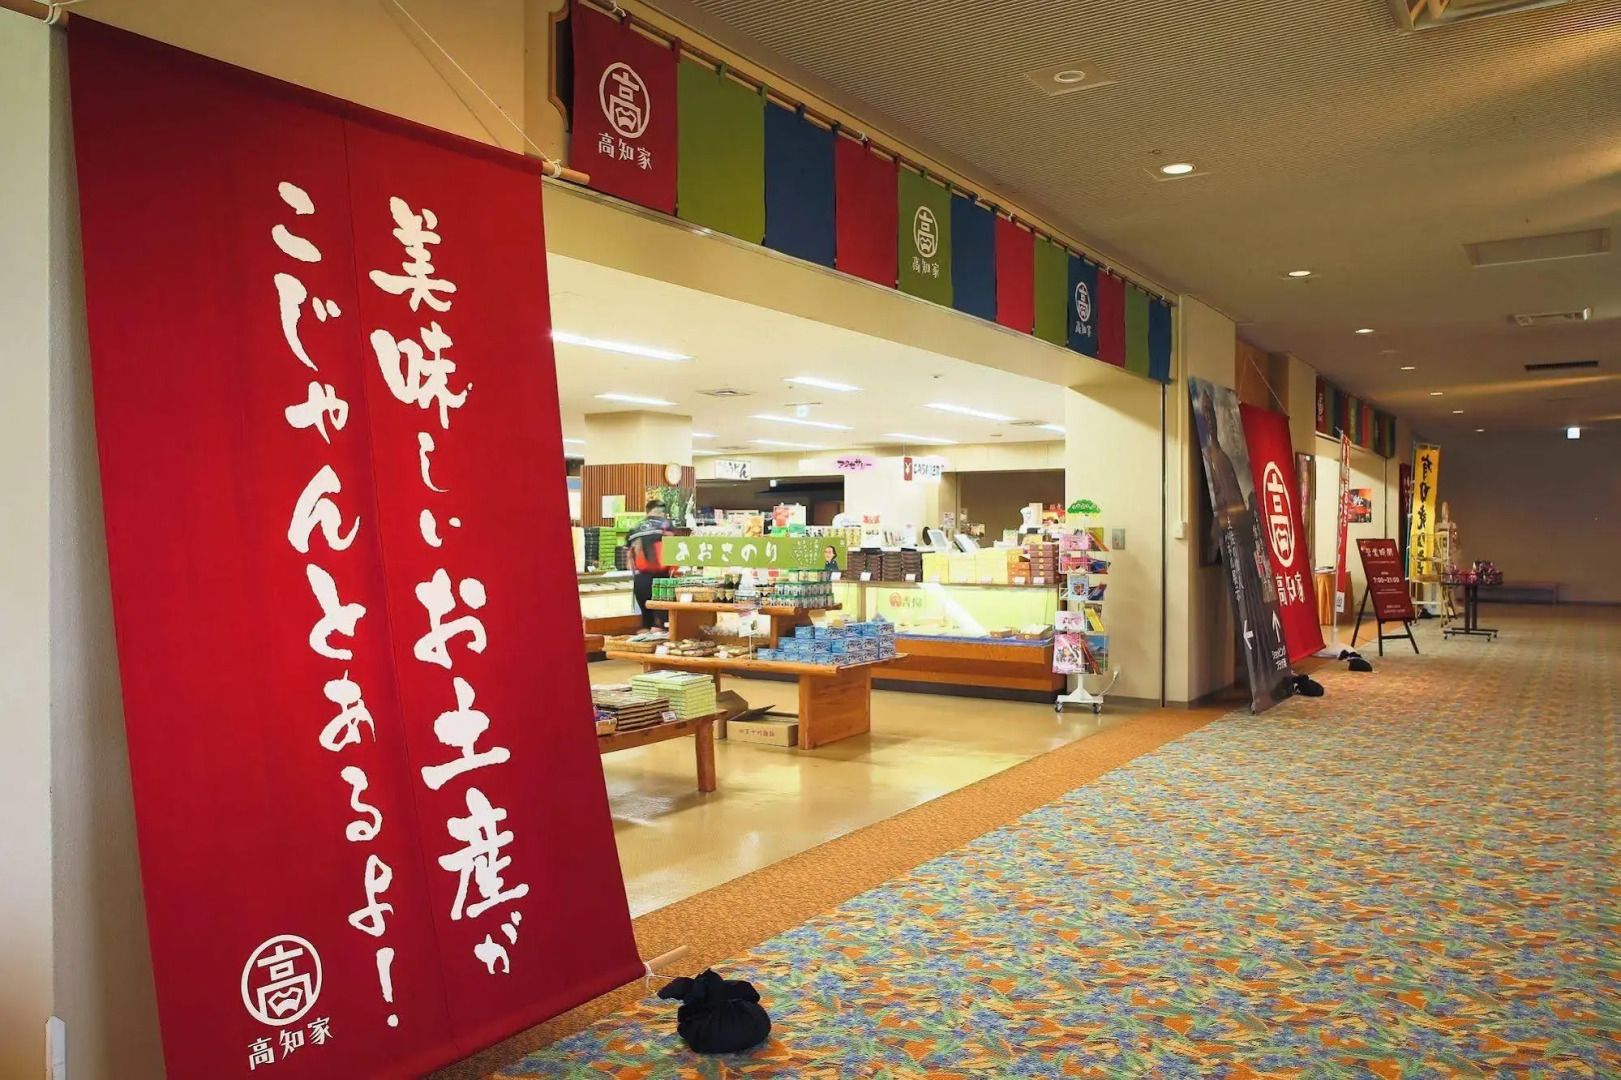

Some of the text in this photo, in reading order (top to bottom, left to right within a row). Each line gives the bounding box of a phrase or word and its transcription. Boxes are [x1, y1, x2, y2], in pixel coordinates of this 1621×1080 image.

[598, 133, 652, 170] 高知家
[912, 256, 940, 279] 高知家
[675, 540, 778, 564] あおさのり
[368, 195, 530, 976] 美味しいお土産が
[1276, 571, 1305, 607] 高知家
[248, 1016, 334, 1071] 高知家
